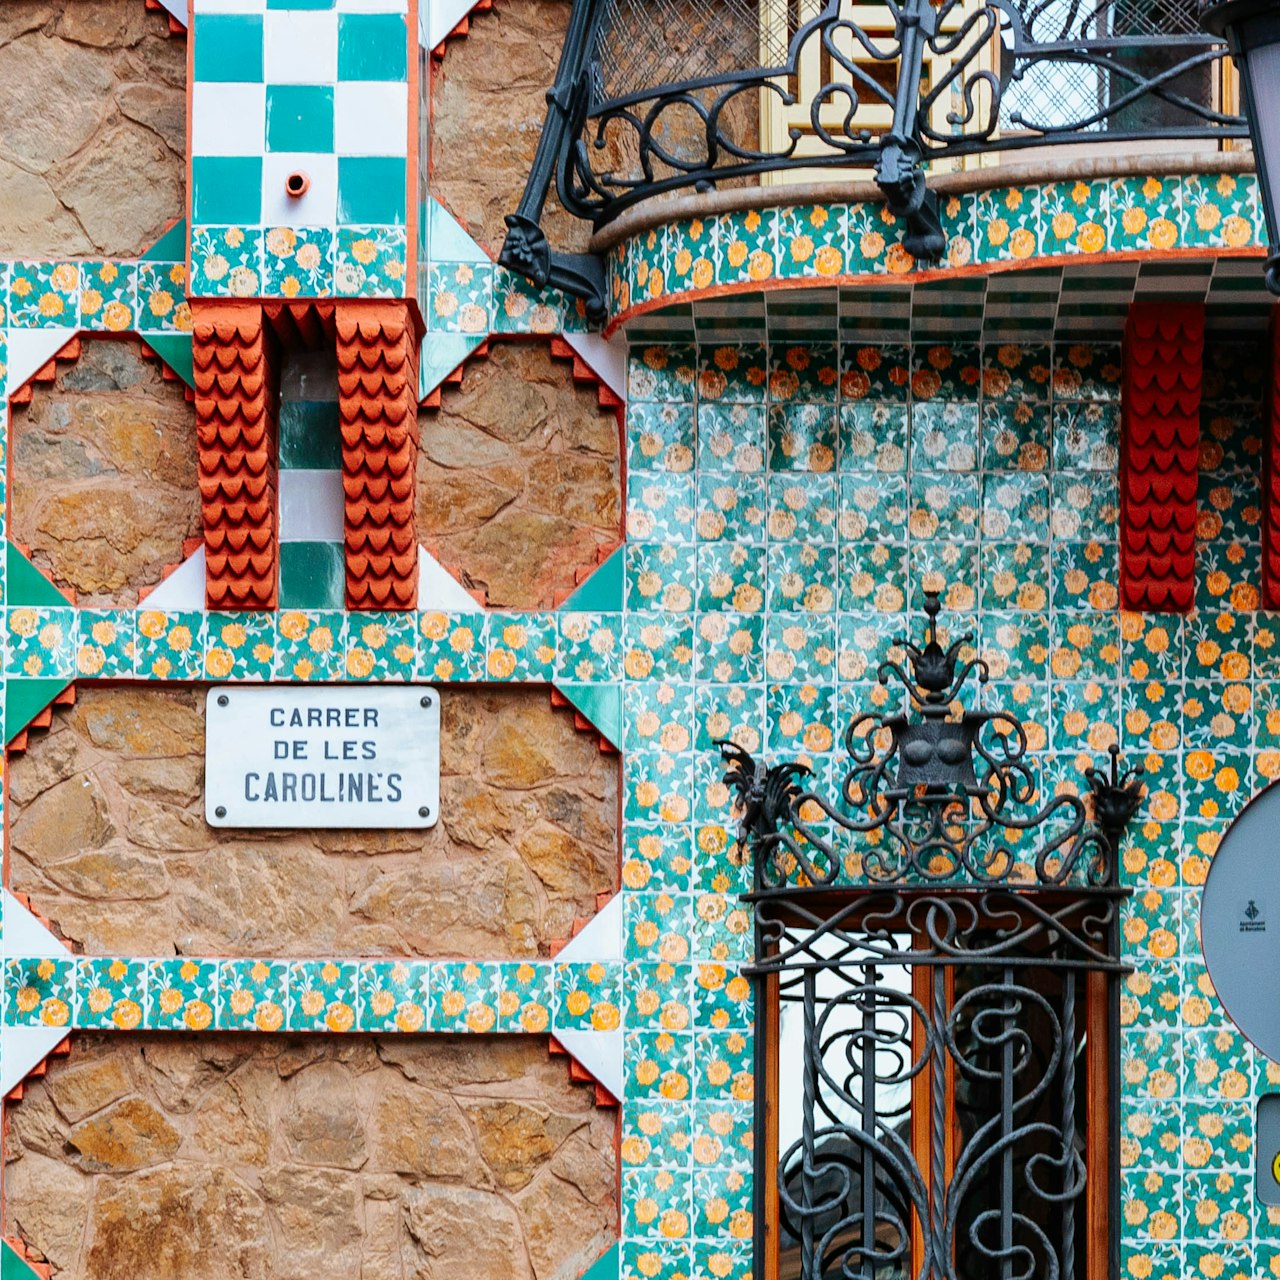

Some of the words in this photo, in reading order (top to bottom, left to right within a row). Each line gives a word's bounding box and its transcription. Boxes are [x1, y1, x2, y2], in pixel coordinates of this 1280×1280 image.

[270, 707, 380, 728] CARRER
[273, 740, 309, 760] DE
[323, 740, 377, 760] LES
[244, 772, 403, 803] CAROLINES
